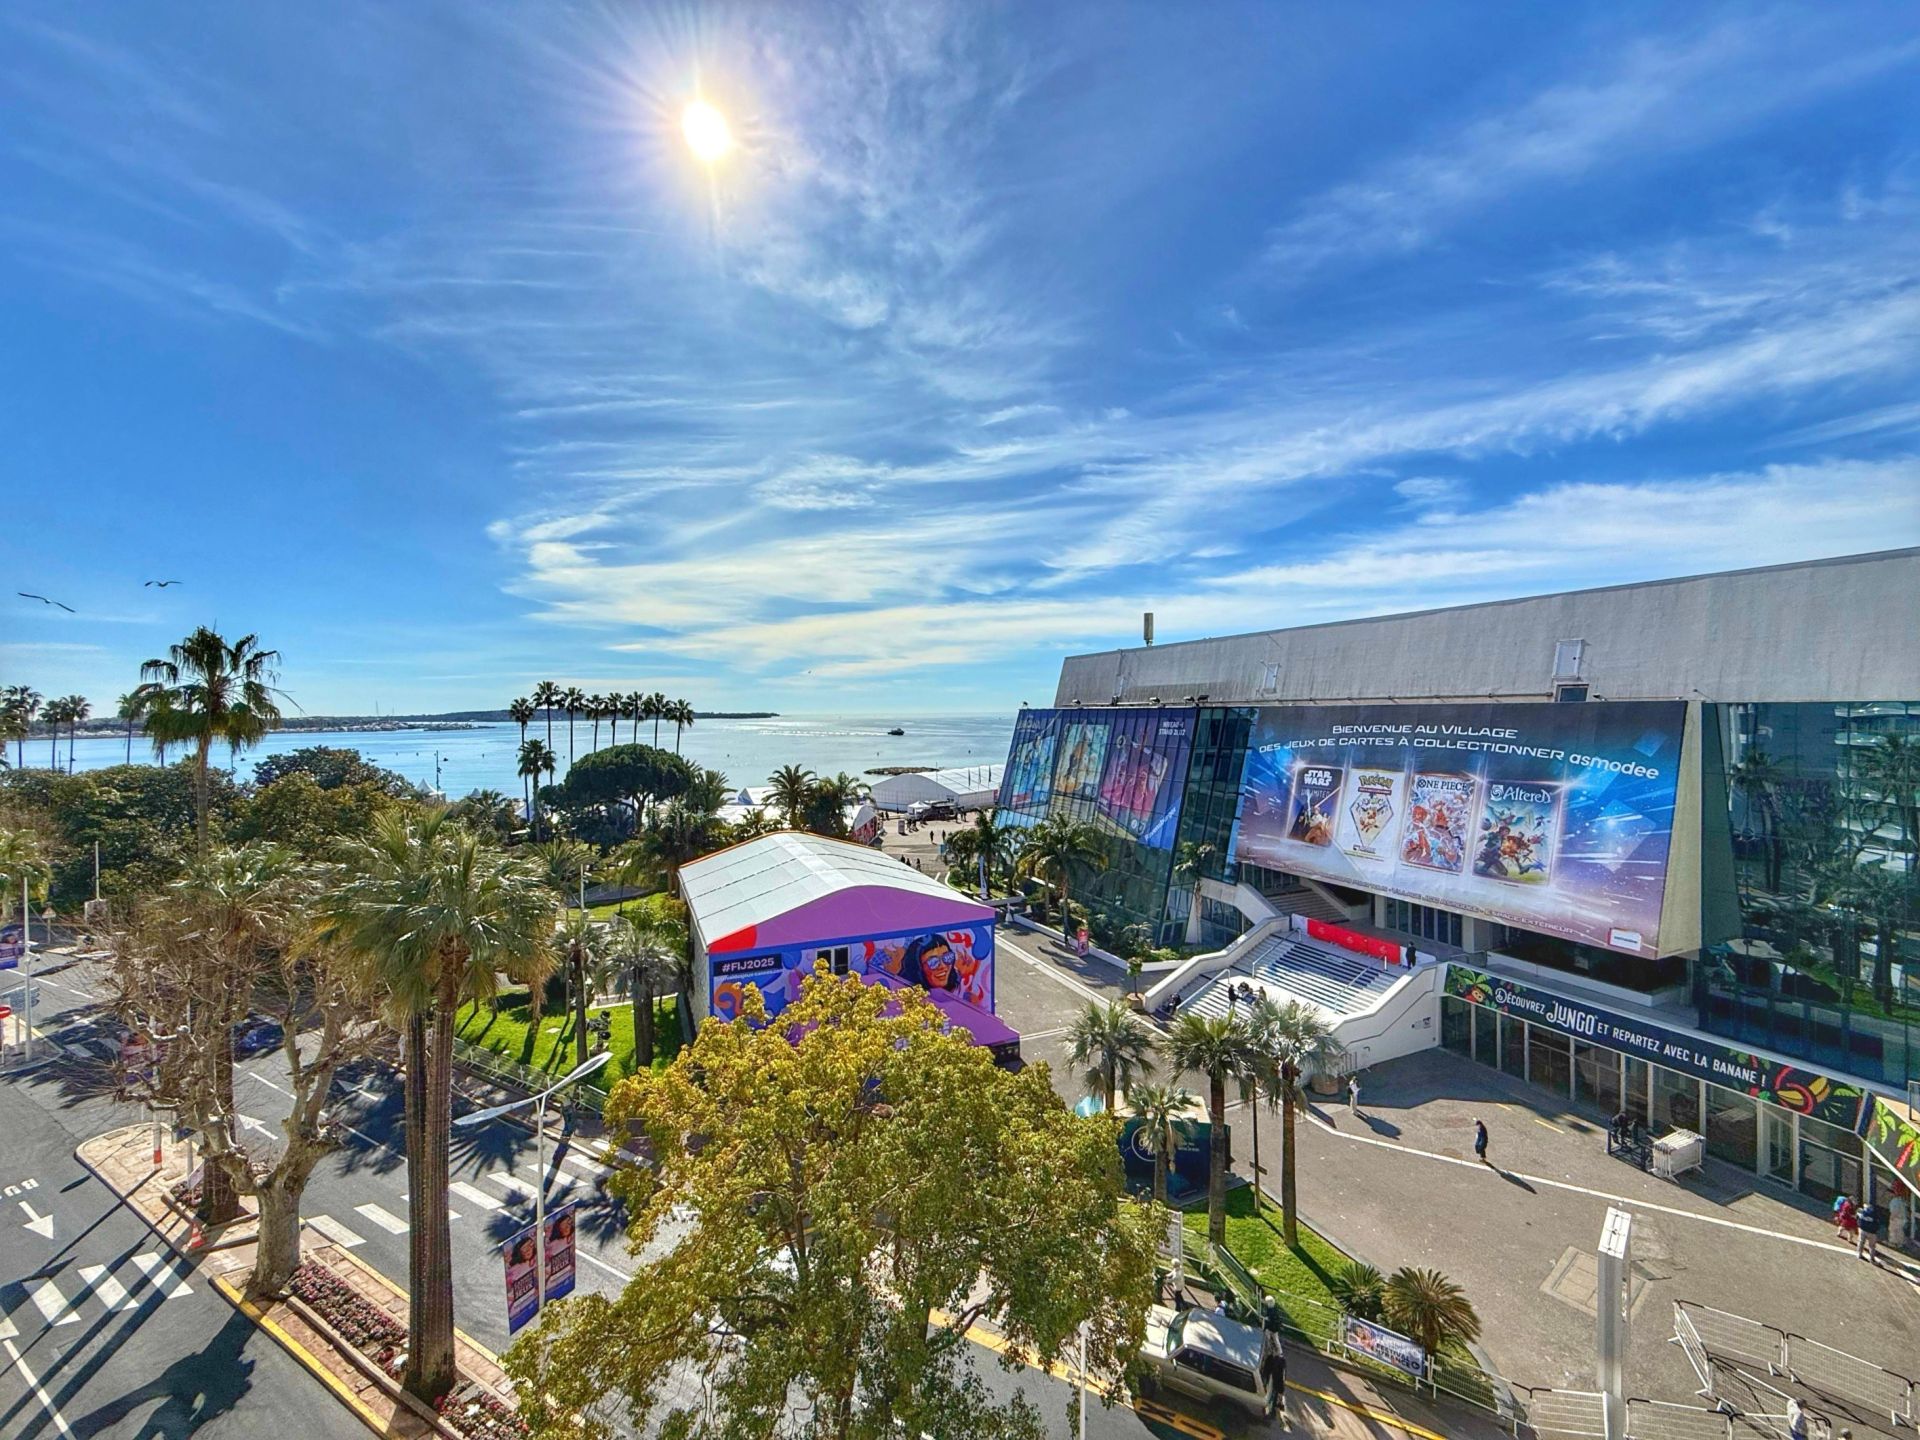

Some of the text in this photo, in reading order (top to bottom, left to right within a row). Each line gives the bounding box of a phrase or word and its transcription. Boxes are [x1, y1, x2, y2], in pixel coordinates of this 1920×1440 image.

[1332, 724, 1518, 739] BIENVENUE AU VILLAGE
[1259, 735, 1659, 779] DES JEUX DE CARTES À COLLECTIONNER asmodee
[1303, 776, 1332, 786] WARS
[1304, 769, 1332, 778] STAR
[1417, 778, 1468, 791] ONE PIECE
[722, 957, 775, 972] #FIJ2025
[1495, 987, 1546, 1015] DÉCOUVREZ
[1597, 1022, 1609, 1035] ET
[1612, 1027, 1660, 1052] REPARTEZ
[1663, 1043, 1690, 1061] AVEC
[1694, 1052, 1708, 1068] LA
[1712, 1059, 1757, 1084] BANANE
[1761, 1074, 1767, 1087] !
[0, 1178, 40, 1198] BU
